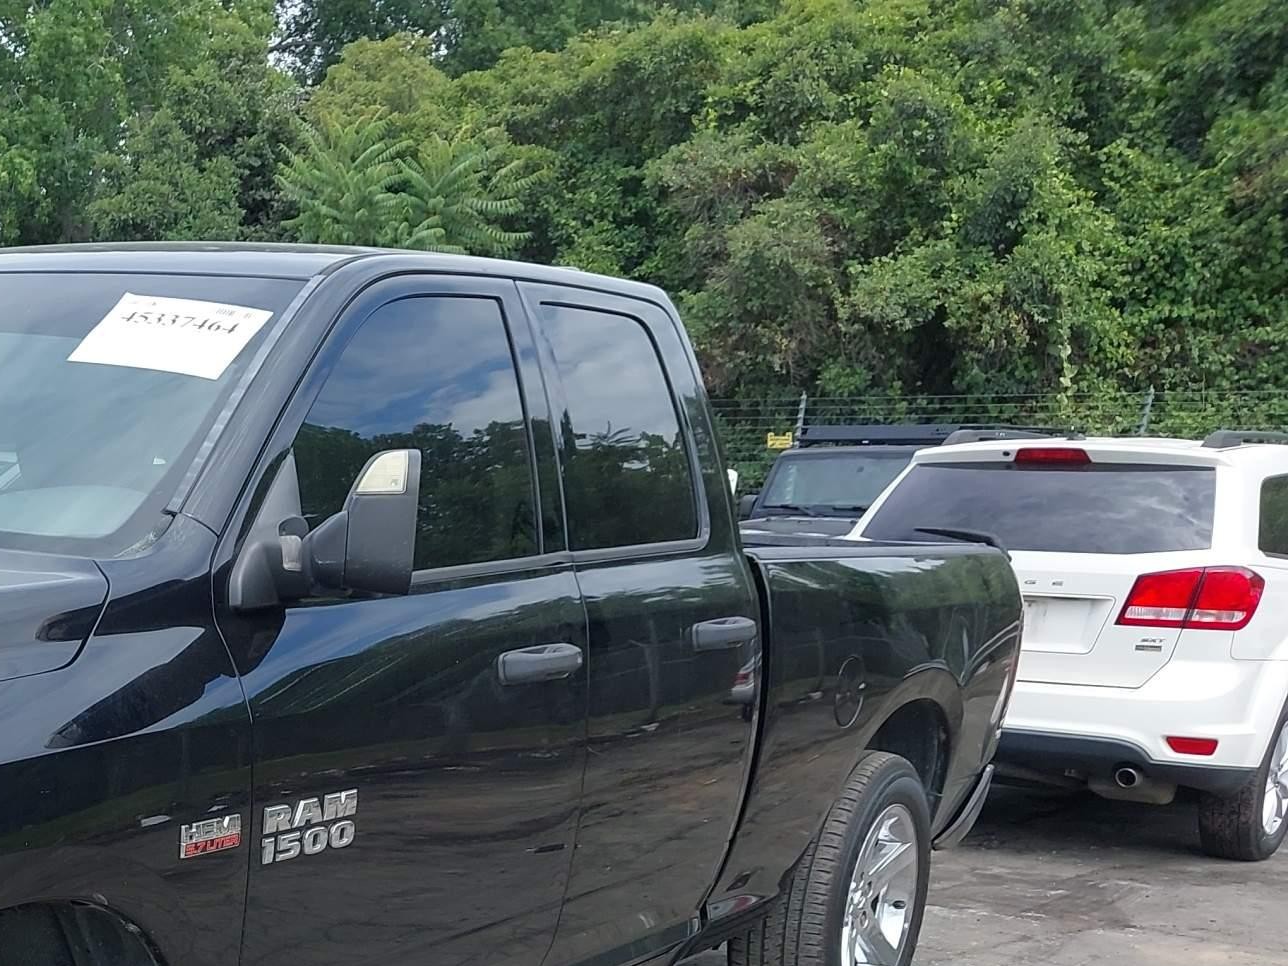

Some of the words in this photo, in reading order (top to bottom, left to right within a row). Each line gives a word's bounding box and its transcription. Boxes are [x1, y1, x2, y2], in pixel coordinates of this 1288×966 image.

[121, 311, 240, 335] 45337464
[263, 789, 358, 834] RAM
[262, 819, 355, 865] 1500
